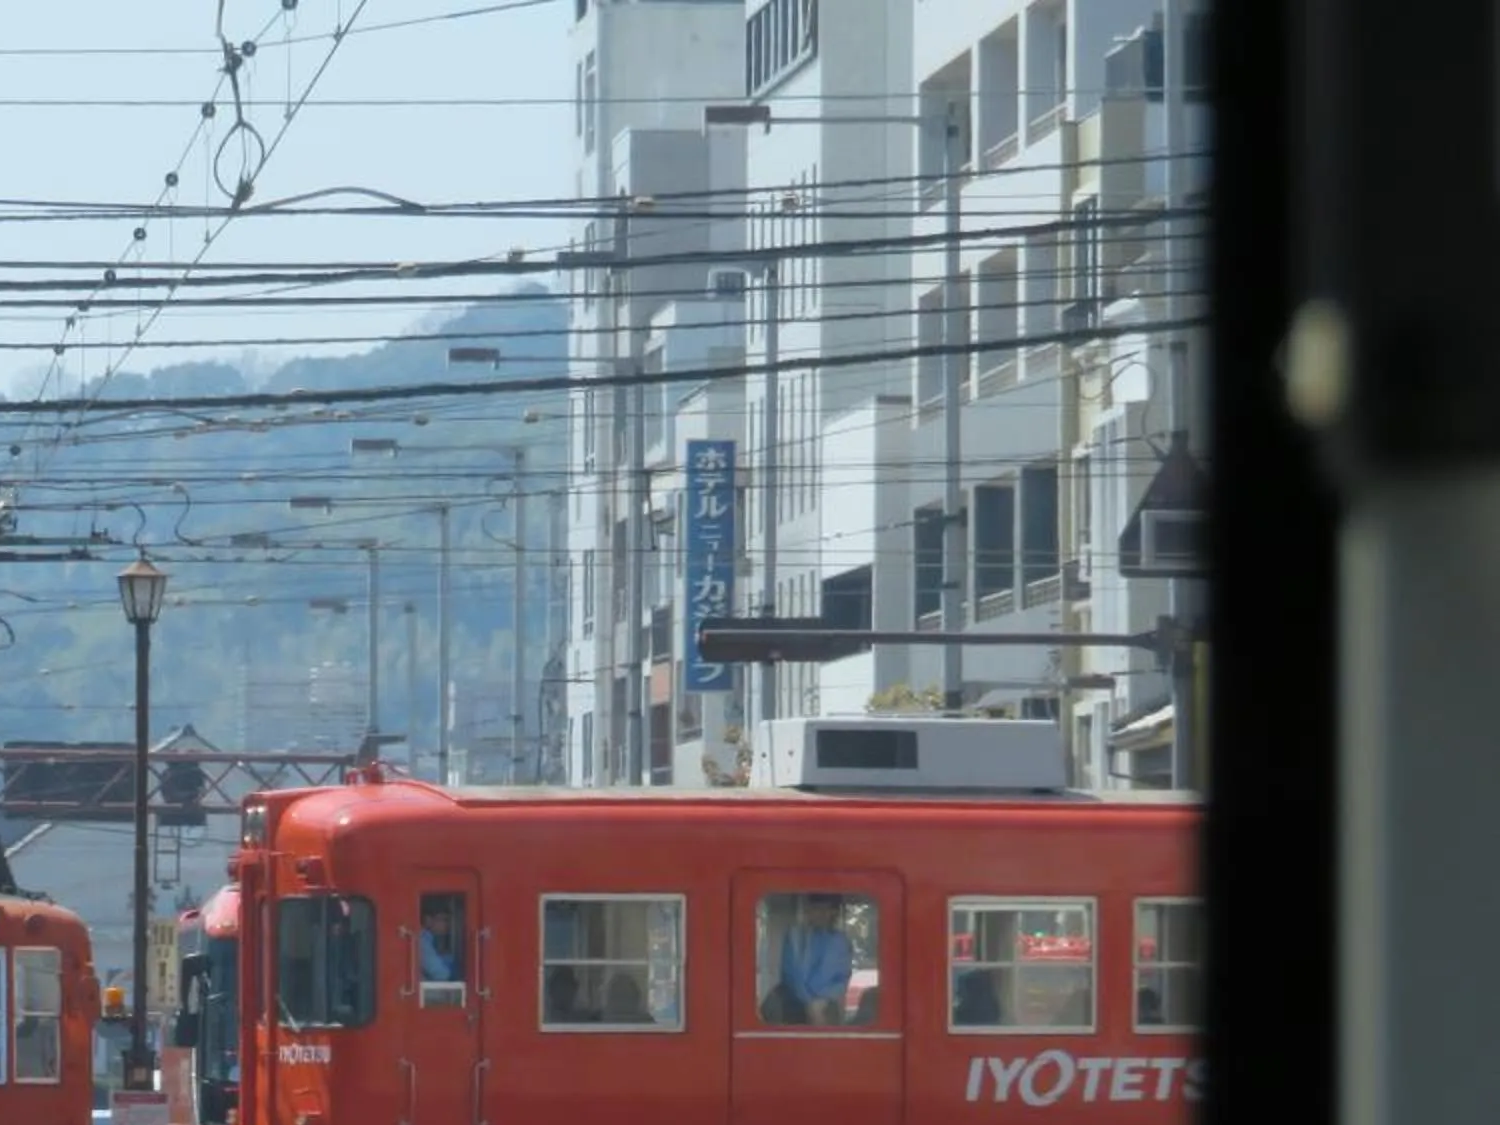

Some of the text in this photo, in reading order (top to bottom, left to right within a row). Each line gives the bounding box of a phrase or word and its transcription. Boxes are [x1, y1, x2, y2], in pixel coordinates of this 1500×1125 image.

[691, 447, 729, 684] ホテルニューカジラ
